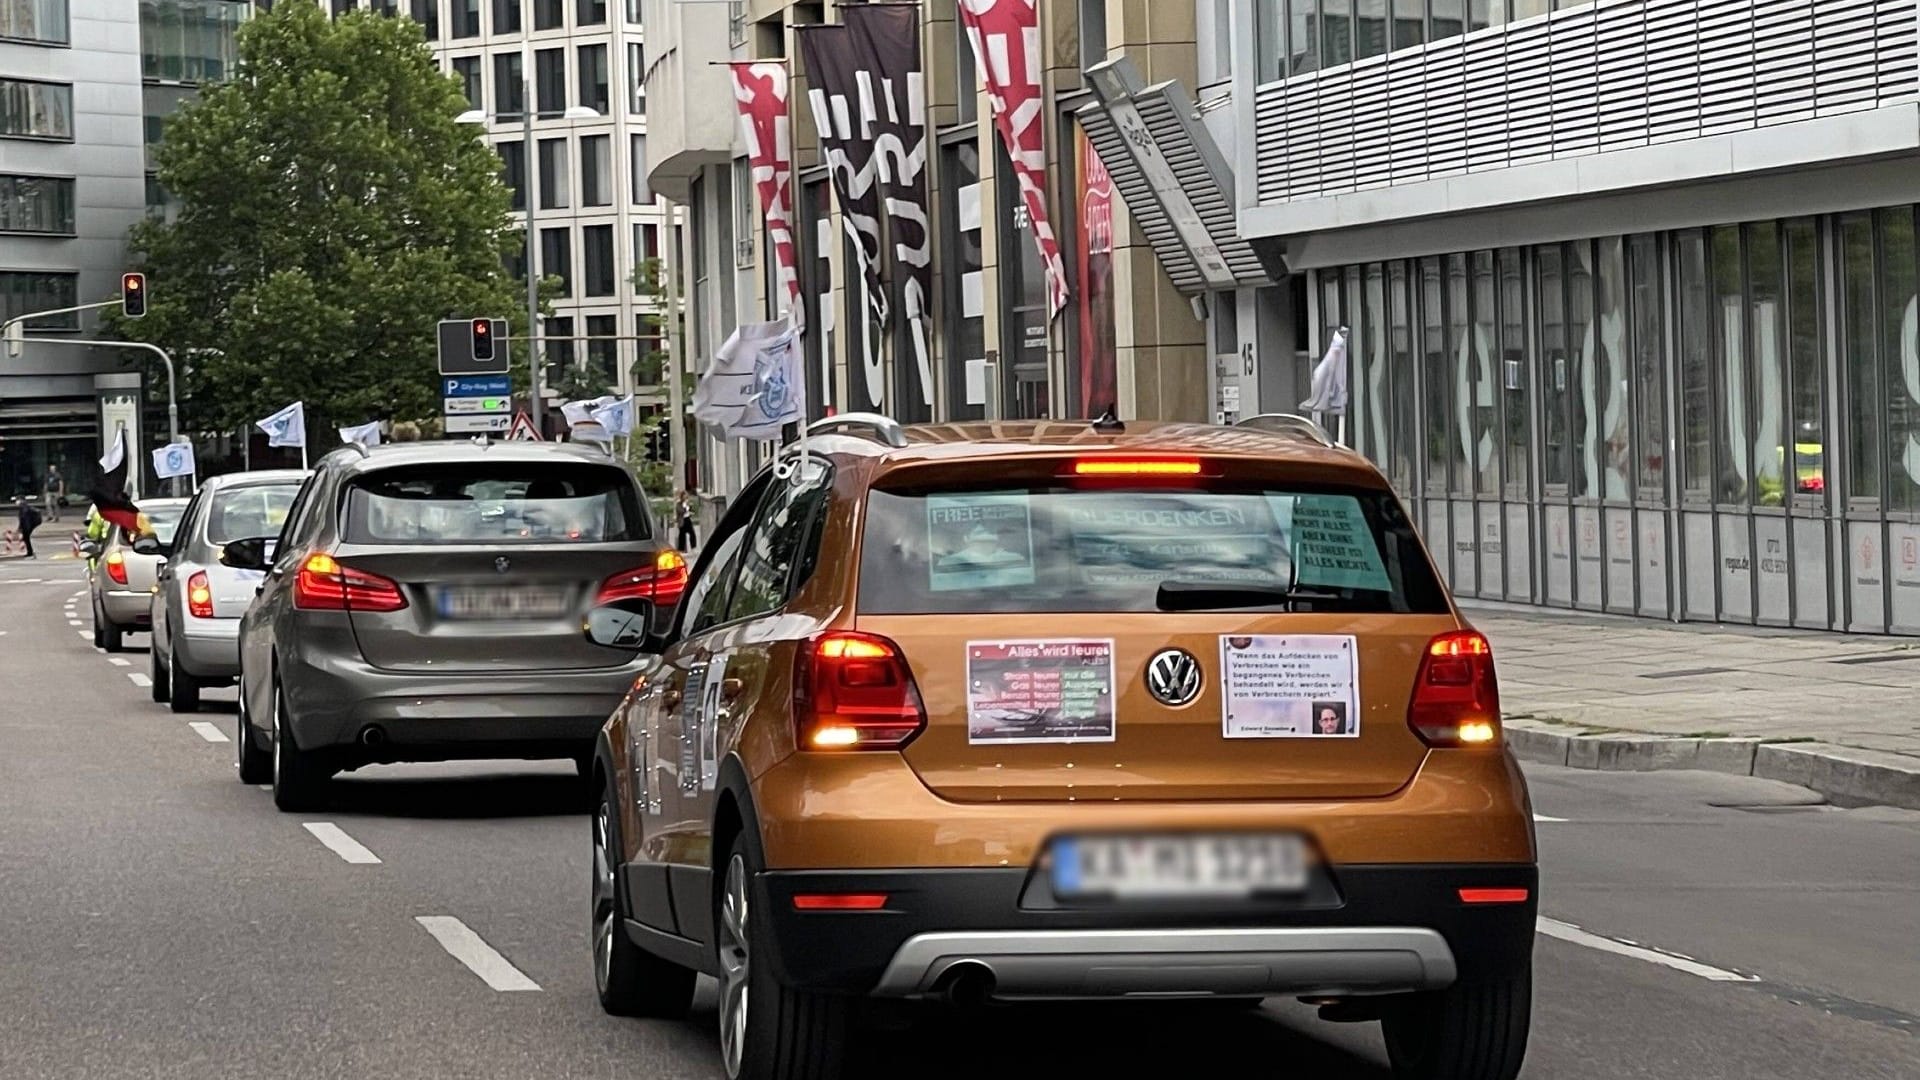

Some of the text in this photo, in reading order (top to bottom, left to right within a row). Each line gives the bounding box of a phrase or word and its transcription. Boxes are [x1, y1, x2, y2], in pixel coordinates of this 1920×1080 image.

[1242, 343, 1254, 376] 15
[932, 507, 982, 524] FREE
[1725, 555, 1749, 573] regus.de
[1008, 646, 1039, 657] Alles
[1042, 646, 1069, 656] wird
[1279, 652, 1321, 660] Aufdecken
[1233, 672, 1282, 680] begangenes
[1011, 681, 1030, 690] Gas
